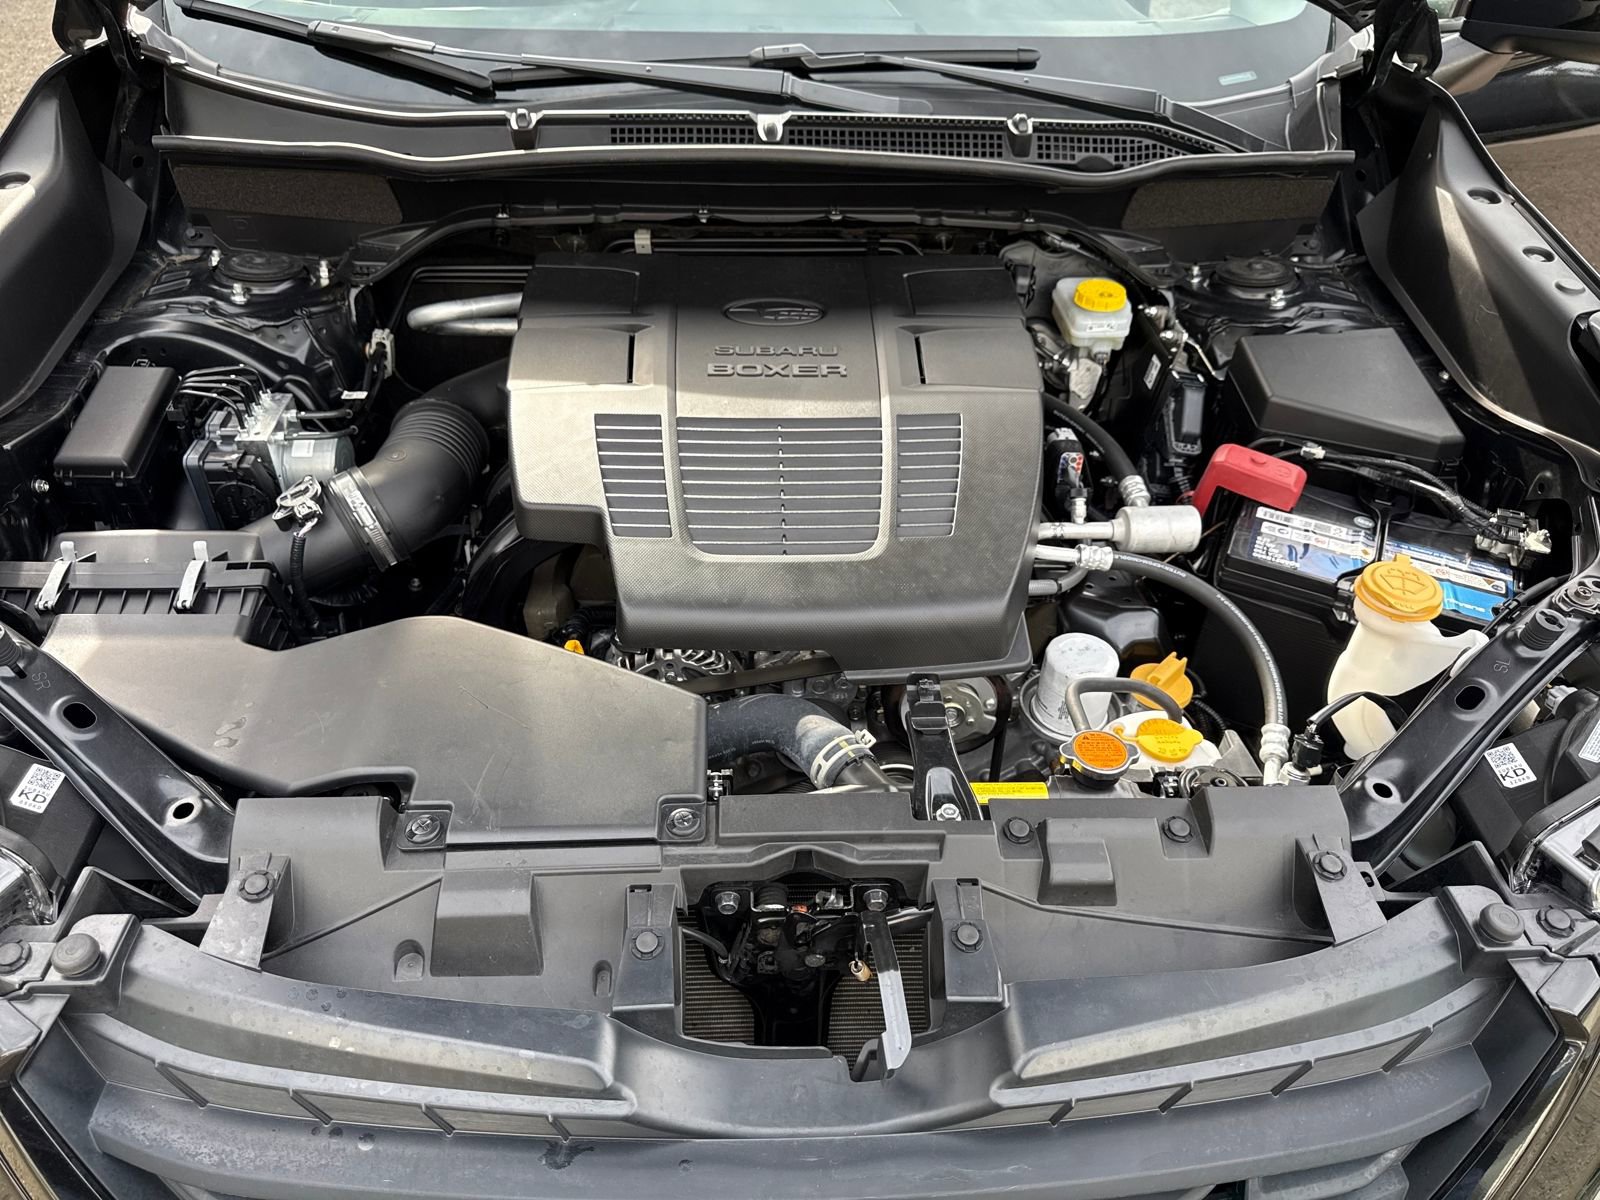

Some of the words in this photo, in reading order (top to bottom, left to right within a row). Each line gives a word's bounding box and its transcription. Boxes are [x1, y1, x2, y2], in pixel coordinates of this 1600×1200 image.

[714, 345, 838, 357] SUBARU
[707, 363, 847, 378] BOXER
[1493, 658, 1511, 673] SL
[32, 671, 50, 690] SR
[1500, 767, 1526, 781] KD
[18, 789, 47, 804] KD
